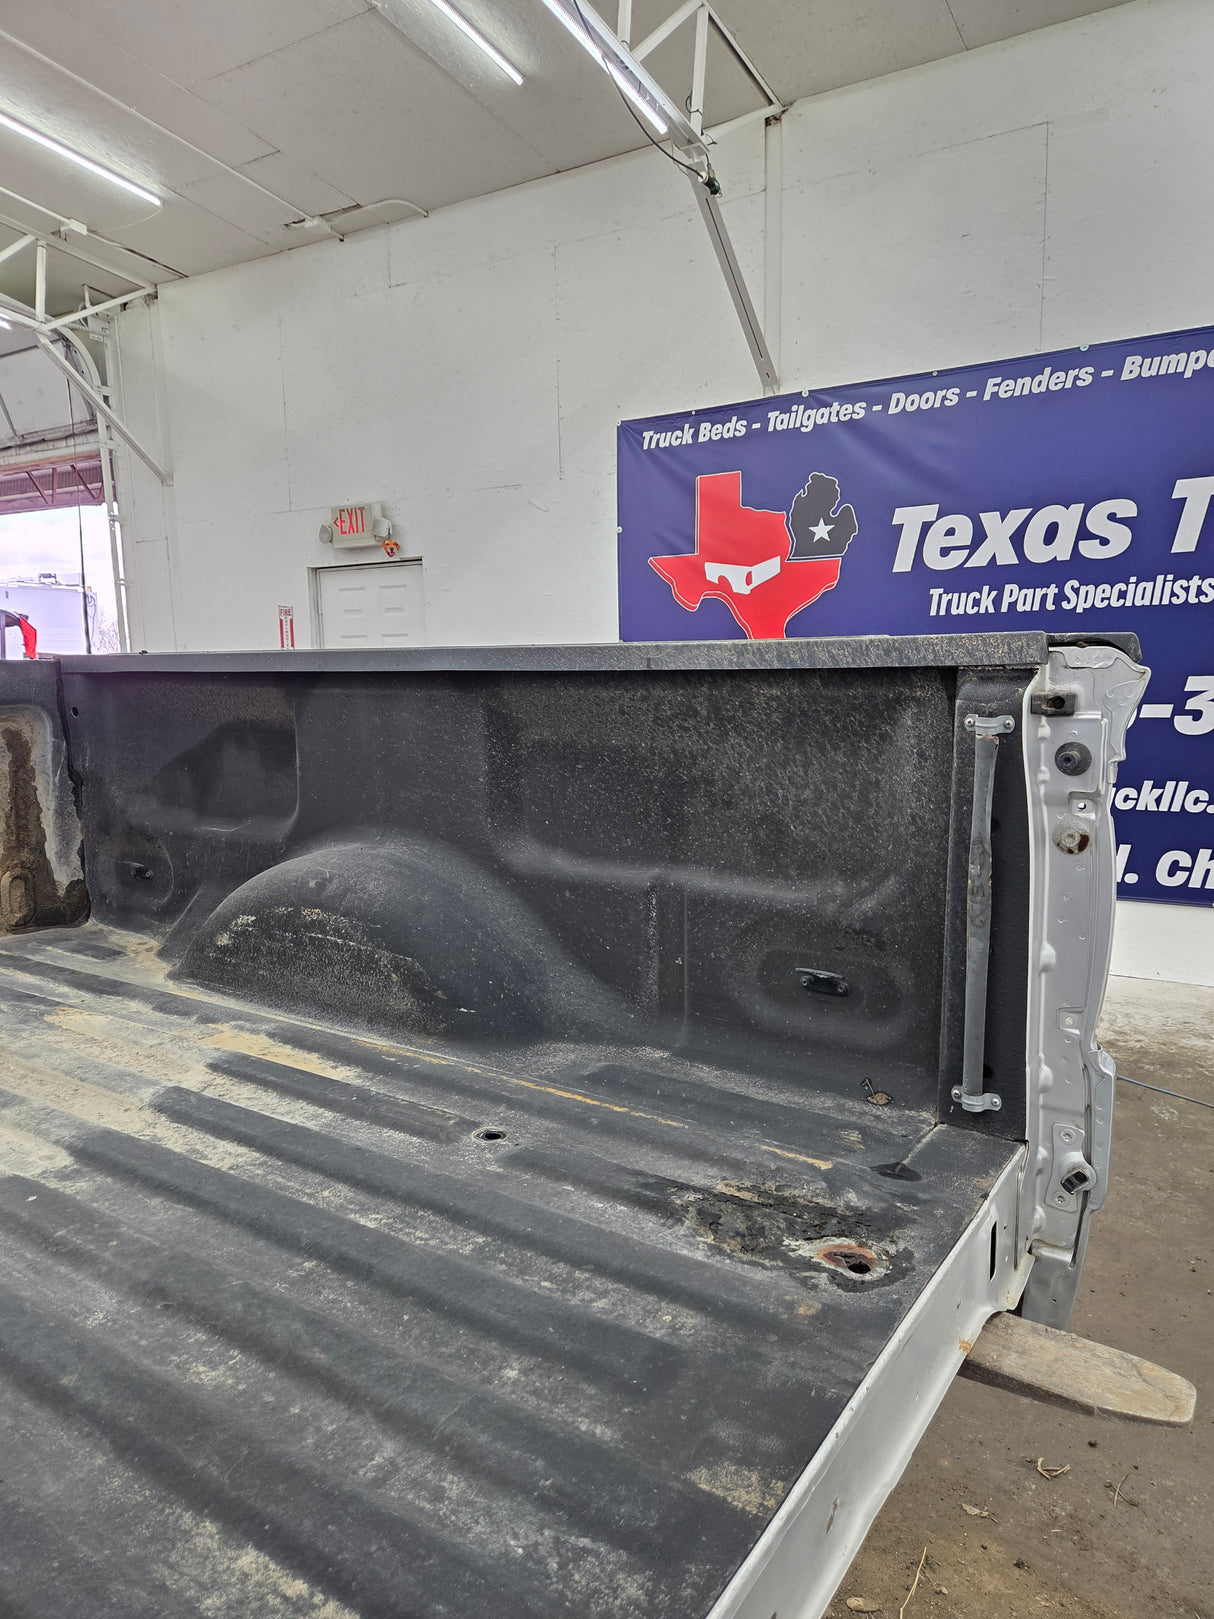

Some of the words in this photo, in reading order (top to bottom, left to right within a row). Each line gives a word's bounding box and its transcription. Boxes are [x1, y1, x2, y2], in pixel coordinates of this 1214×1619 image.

[642, 423, 695, 451] Truck
[697, 415, 748, 443] Beds
[767, 401, 867, 433] Tailgates
[887, 387, 961, 415] Doors
[983, 366, 1095, 401] Fenders
[338, 506, 365, 535] EXIT
[891, 498, 1138, 573] Texas
[1170, 475, 1214, 554] T
[929, 585, 998, 616] Truck
[1000, 583, 1058, 613] Part
[1061, 574, 1214, 613] Specialists
[1127, 675, 1214, 736] -3
[1110, 780, 1214, 814] ckllc.
